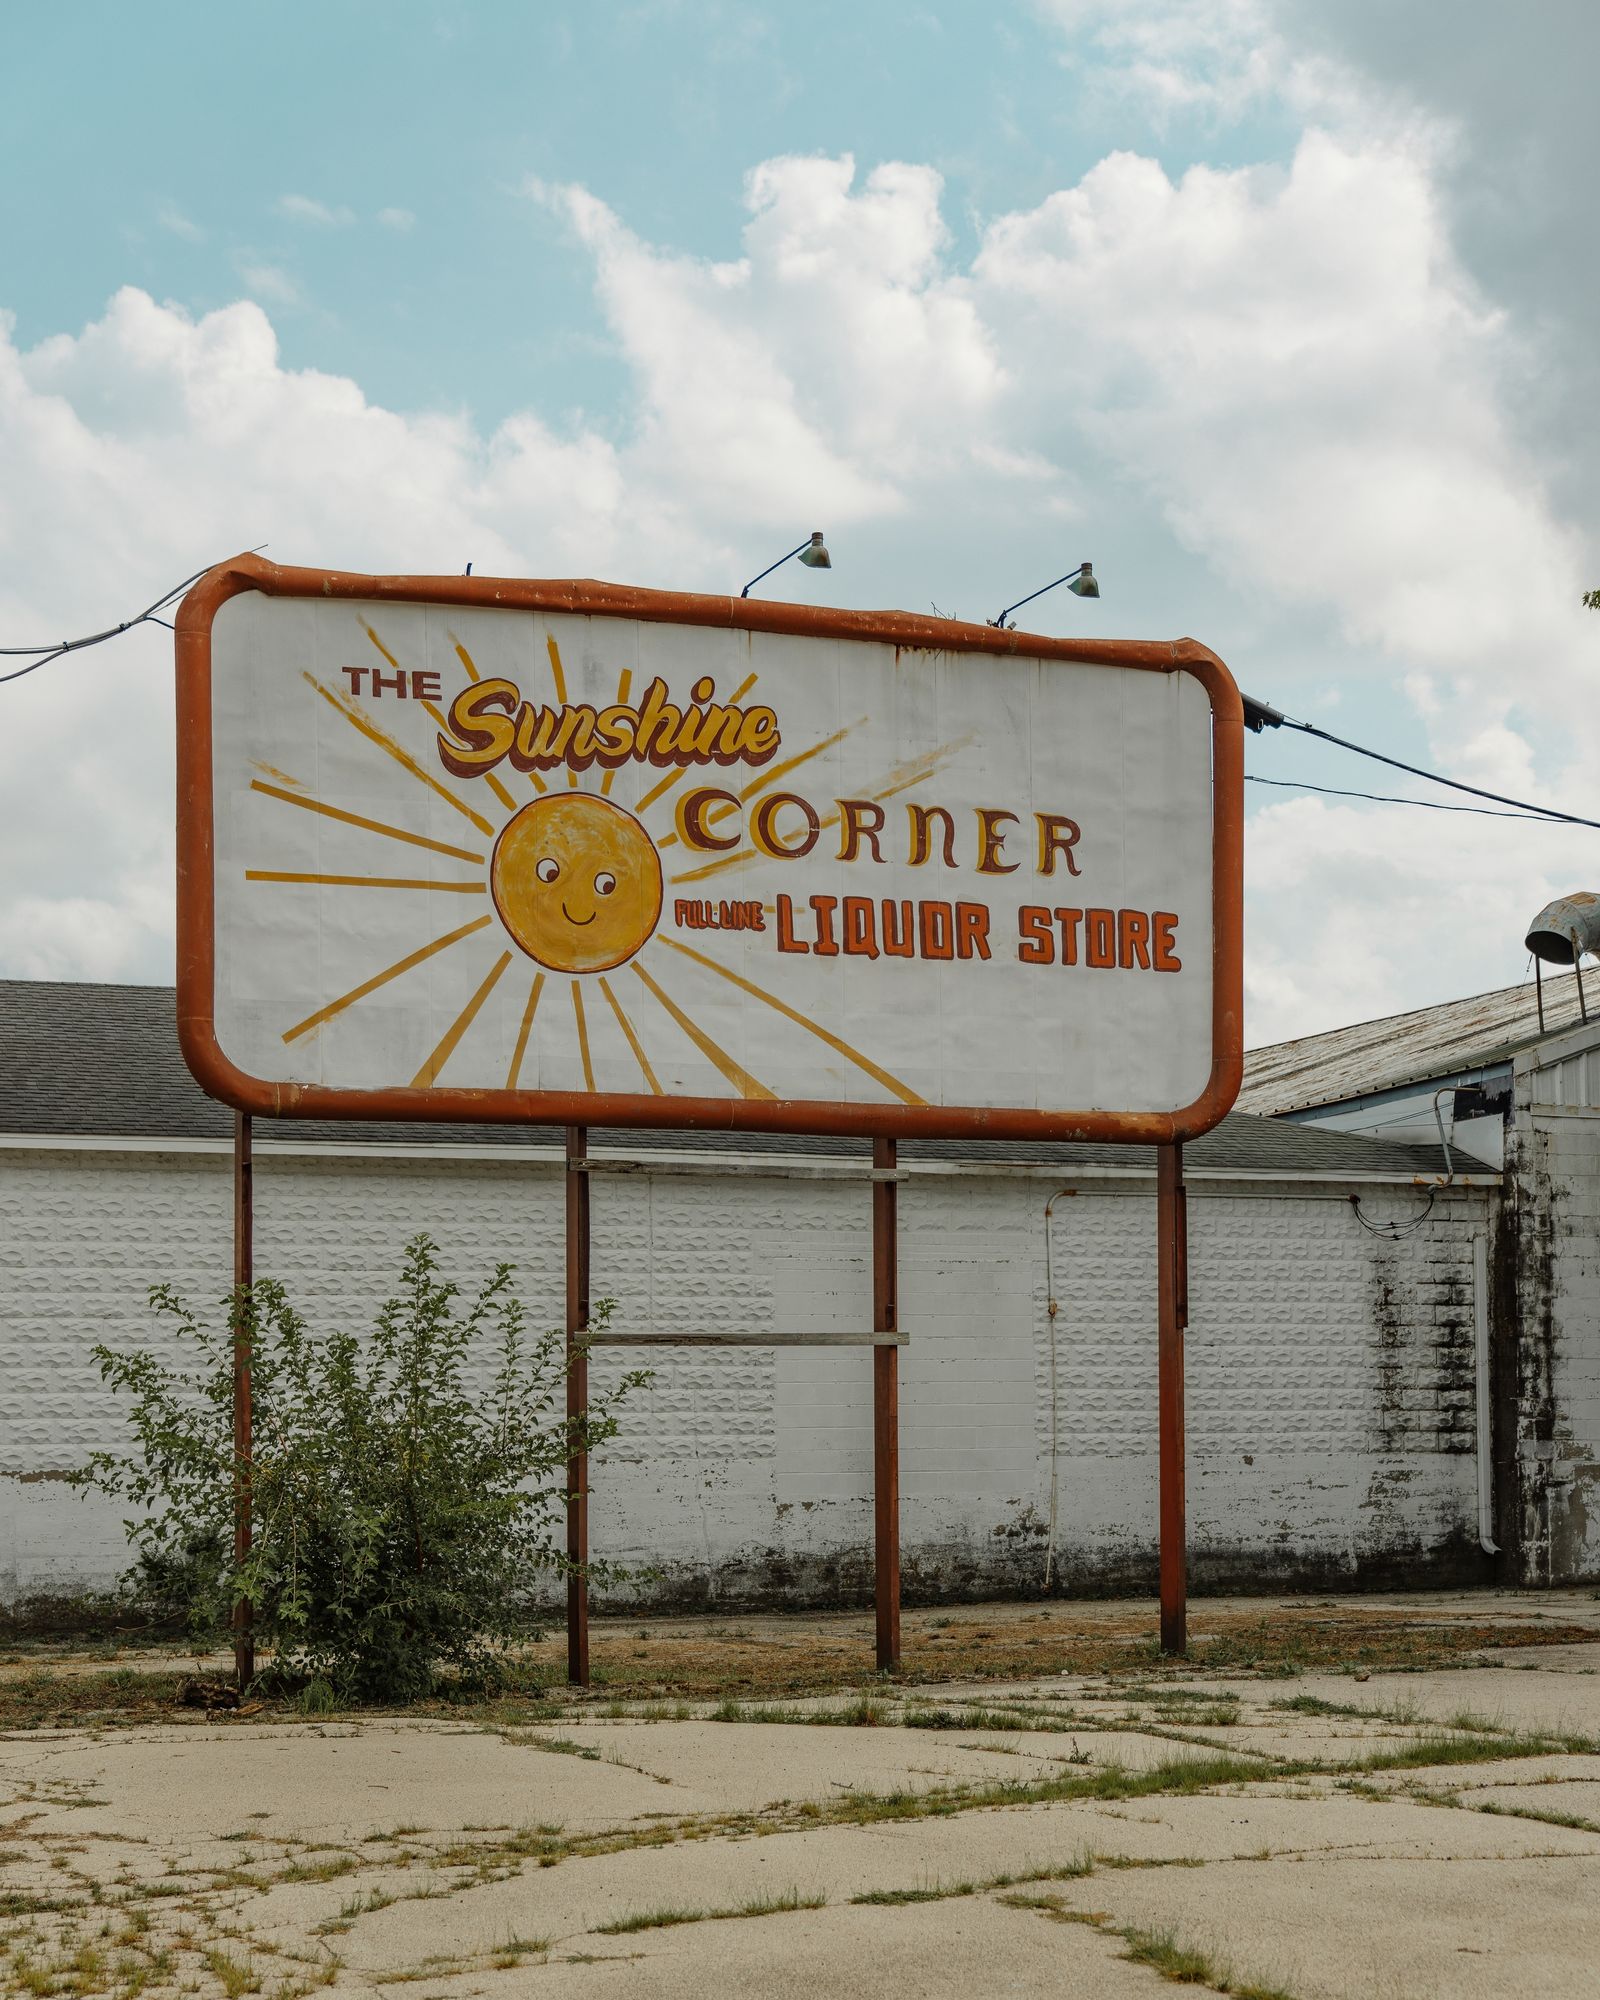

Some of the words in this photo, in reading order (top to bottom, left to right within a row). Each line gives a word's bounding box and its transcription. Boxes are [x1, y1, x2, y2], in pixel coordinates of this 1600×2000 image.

[342, 666, 442, 701] THE
[437, 676, 782, 779] Sunshine
[674, 899, 719, 930] FULL
[718, 900, 766, 932] LINE
[776, 893, 992, 961] LIQUOR
[1018, 905, 1182, 973] STORE
